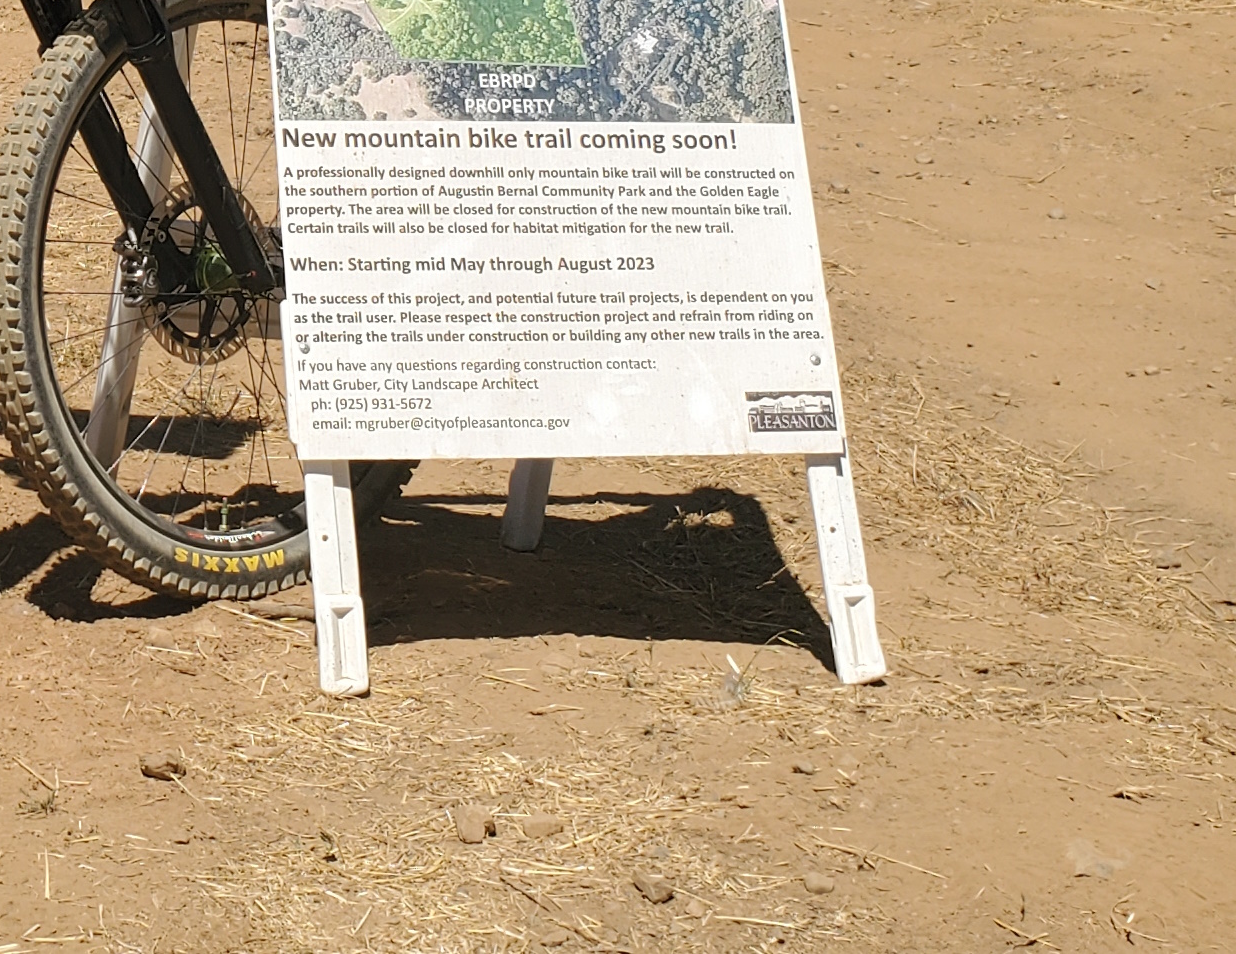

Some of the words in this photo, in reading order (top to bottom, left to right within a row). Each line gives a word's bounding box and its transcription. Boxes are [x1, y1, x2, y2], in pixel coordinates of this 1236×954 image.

[478, 73, 536, 88] EBRPD
[465, 98, 555, 114] PROPERTY
[281, 127, 337, 148] New
[344, 127, 460, 148] mountain
[467, 127, 517, 148] bike
[523, 127, 572, 149] trail
[579, 128, 666, 154] coming
[672, 128, 737, 150] soon!
[283, 166, 293, 178] A
[296, 165, 385, 180] professionally
[388, 166, 446, 181] designed
[448, 166, 504, 178] downhill
[507, 166, 535, 181] only
[538, 166, 599, 179] mountain
[601, 166, 629, 179] bike
[631, 166, 657, 179] trail
[659, 166, 682, 179] will
[684, 167, 701, 179] be
[703, 167, 776, 179] constructed
[778, 170, 795, 179] on
[286, 204, 345, 218] property.
[347, 203, 372, 215] The
[375, 206, 404, 215] area
[406, 203, 430, 215] will
[433, 203, 450, 215] be
[452, 203, 493, 215] closed
[496, 202, 515, 215] for
[518, 203, 597, 215] construction
[600, 203, 613, 215] of
[616, 203, 638, 215] the
[641, 206, 668, 215] new
[671, 203, 731, 215] mountain
[733, 203, 760, 215] bike
[762, 203, 791, 215] trail.
[289, 256, 343, 271] When:
[347, 256, 411, 275] Starting
[415, 256, 445, 271] mid
[450, 257, 485, 274] May
[488, 256, 553, 274] through
[557, 257, 613, 274] August
[616, 256, 655, 271] 2023
[291, 292, 317, 305] The
[319, 295, 368, 305] success
[370, 292, 384, 305] of
[387, 292, 412, 304] this
[414, 292, 465, 307] project,
[467, 291, 492, 304] and
[495, 291, 553, 307] potential
[556, 291, 597, 304] future
[599, 291, 625, 304] trail
[628, 291, 683, 306] projects,
[686, 290, 697, 303] is
[699, 290, 768, 305] dependent
[771, 293, 787, 302] on
[789, 293, 814, 305] you
[297, 358, 306, 372] If
[308, 362, 333, 374] you
[336, 358, 367, 372] have
[370, 362, 392, 374] any
[395, 358, 457, 374] questions
[460, 358, 521, 374] regarding
[523, 357, 603, 370] construction
[605, 358, 656, 370] contact:
[298, 378, 330, 391] Matt
[332, 378, 381, 392] Gruber,
[383, 378, 408, 393] City
[411, 377, 478, 393] Landscape
[481, 376, 539, 390] Architect
[310, 397, 331, 413] ph:
[335, 397, 368, 413] (925)
[371, 397, 432, 410] 931-5672
[312, 416, 351, 430] email:
[354, 415, 570, 432] mgruber@cityofpleasantonca.gov
[747, 414, 836, 433] PLEASANTON
[174, 547, 285, 573] MAXXIS
